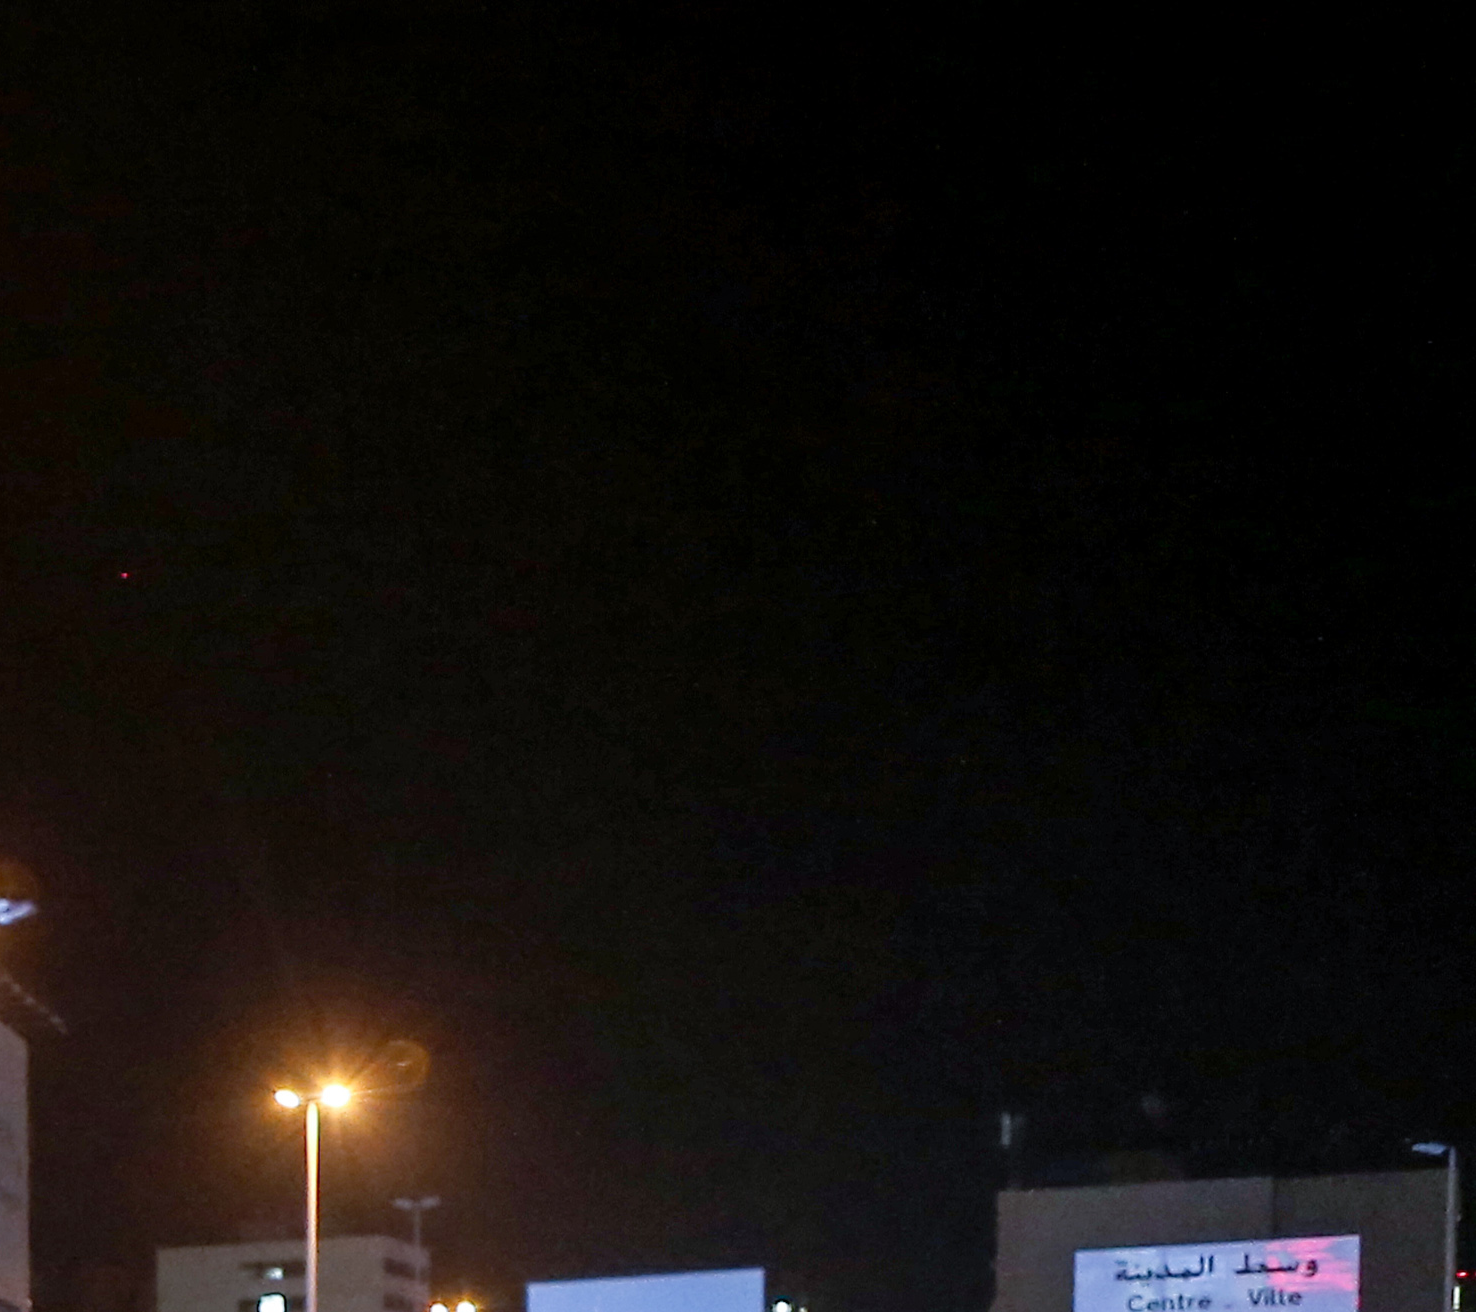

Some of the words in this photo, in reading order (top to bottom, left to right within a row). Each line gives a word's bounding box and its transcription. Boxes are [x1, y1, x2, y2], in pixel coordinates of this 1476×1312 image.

[1114, 1254, 1214, 1282] المدينة
[1233, 1253, 1319, 1277] وسط
[1248, 1289, 1303, 1308] Ville
